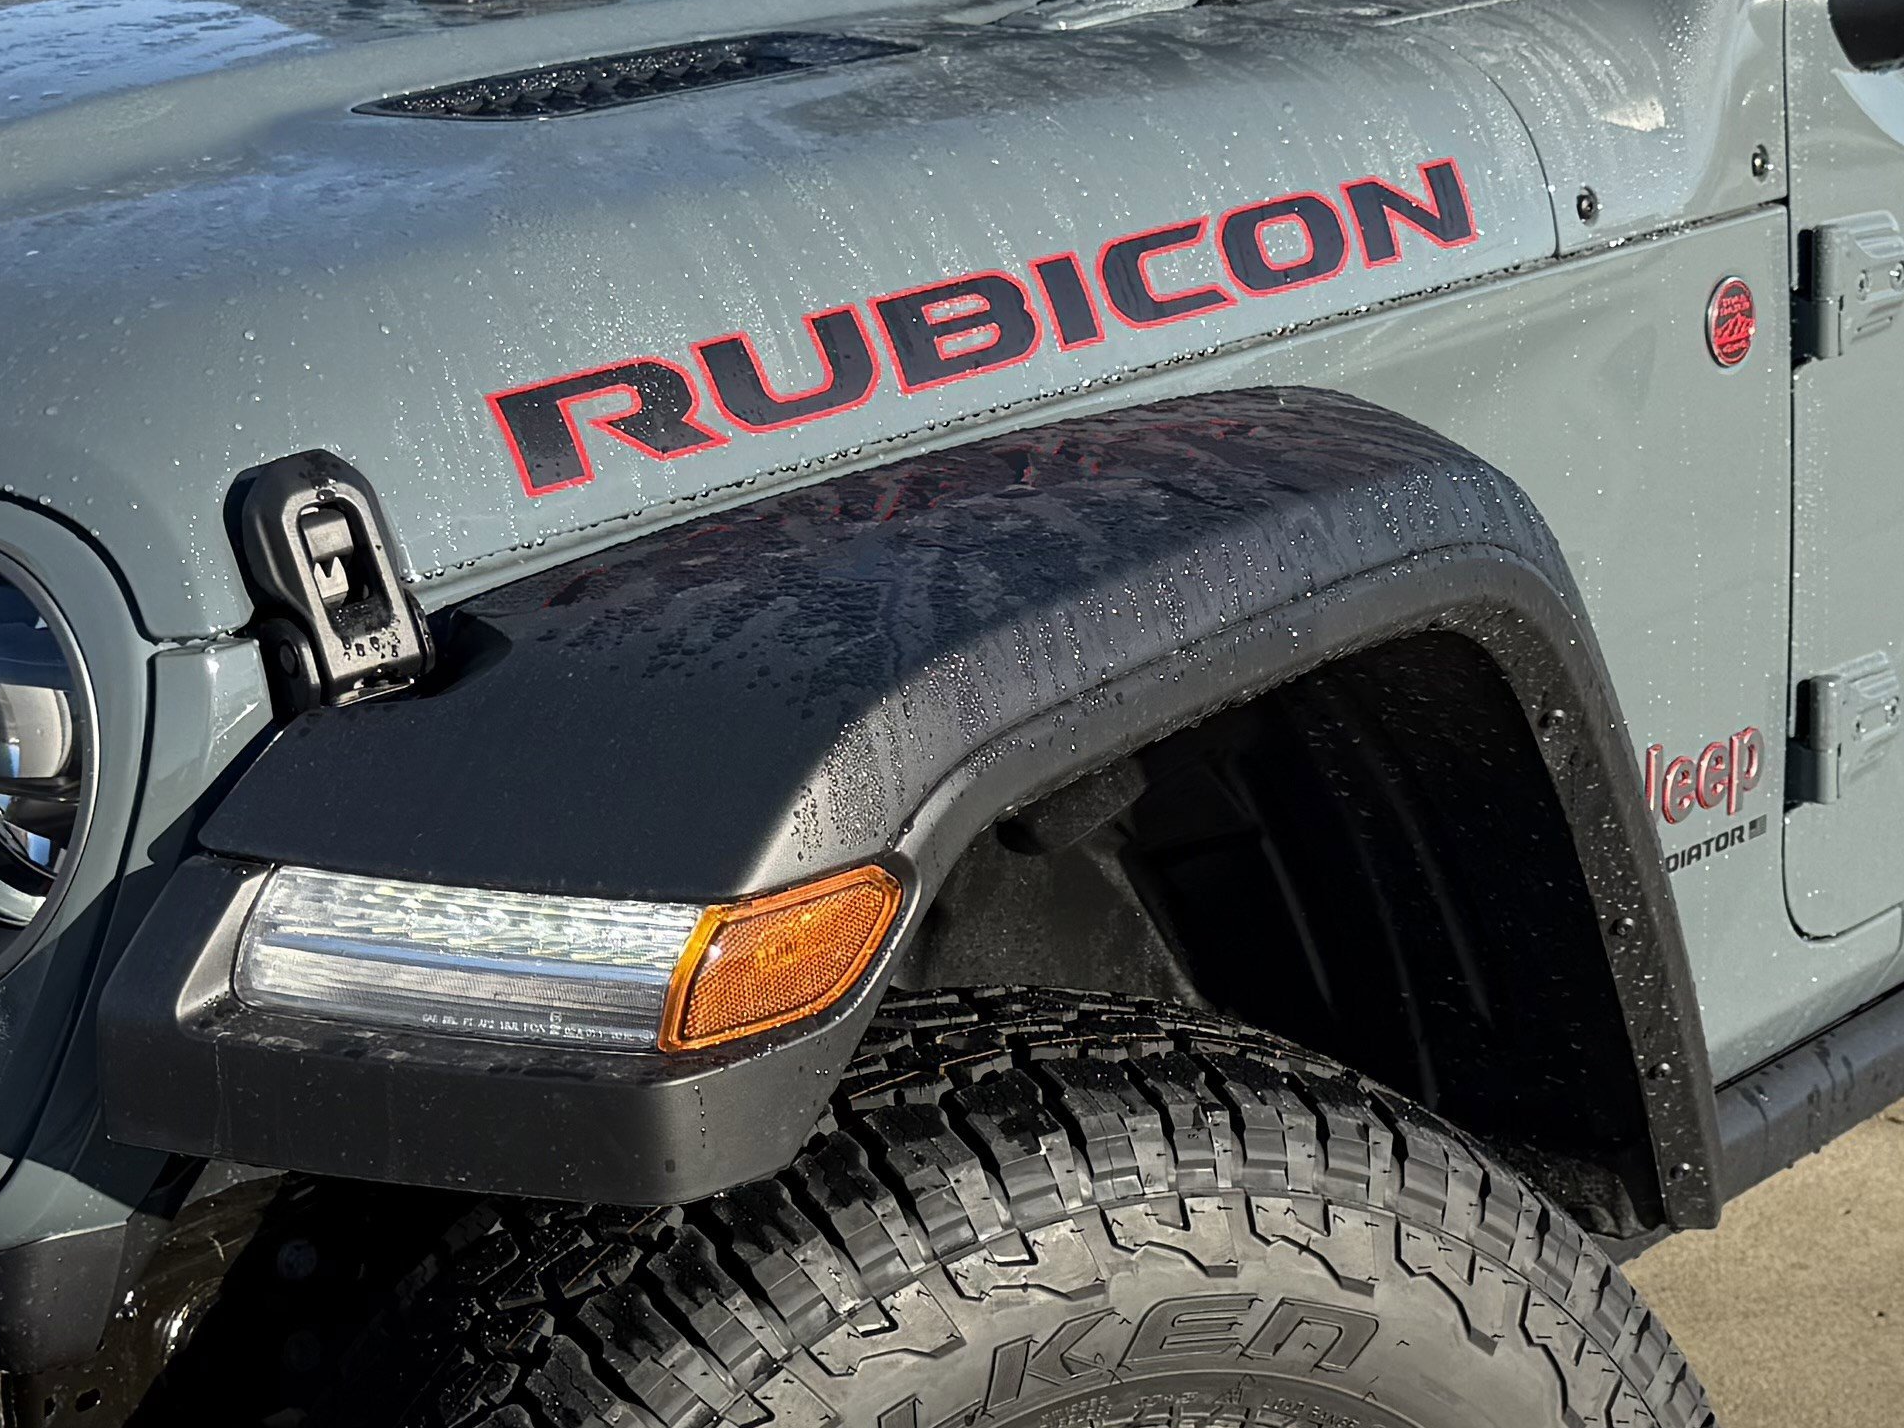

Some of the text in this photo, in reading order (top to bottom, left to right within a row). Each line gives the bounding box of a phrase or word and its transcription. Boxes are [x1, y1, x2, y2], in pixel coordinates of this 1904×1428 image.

[482, 157, 1477, 497] RUBICON
[1645, 726, 1765, 825] Jeep
[1665, 825, 1745, 873] DIATOR
